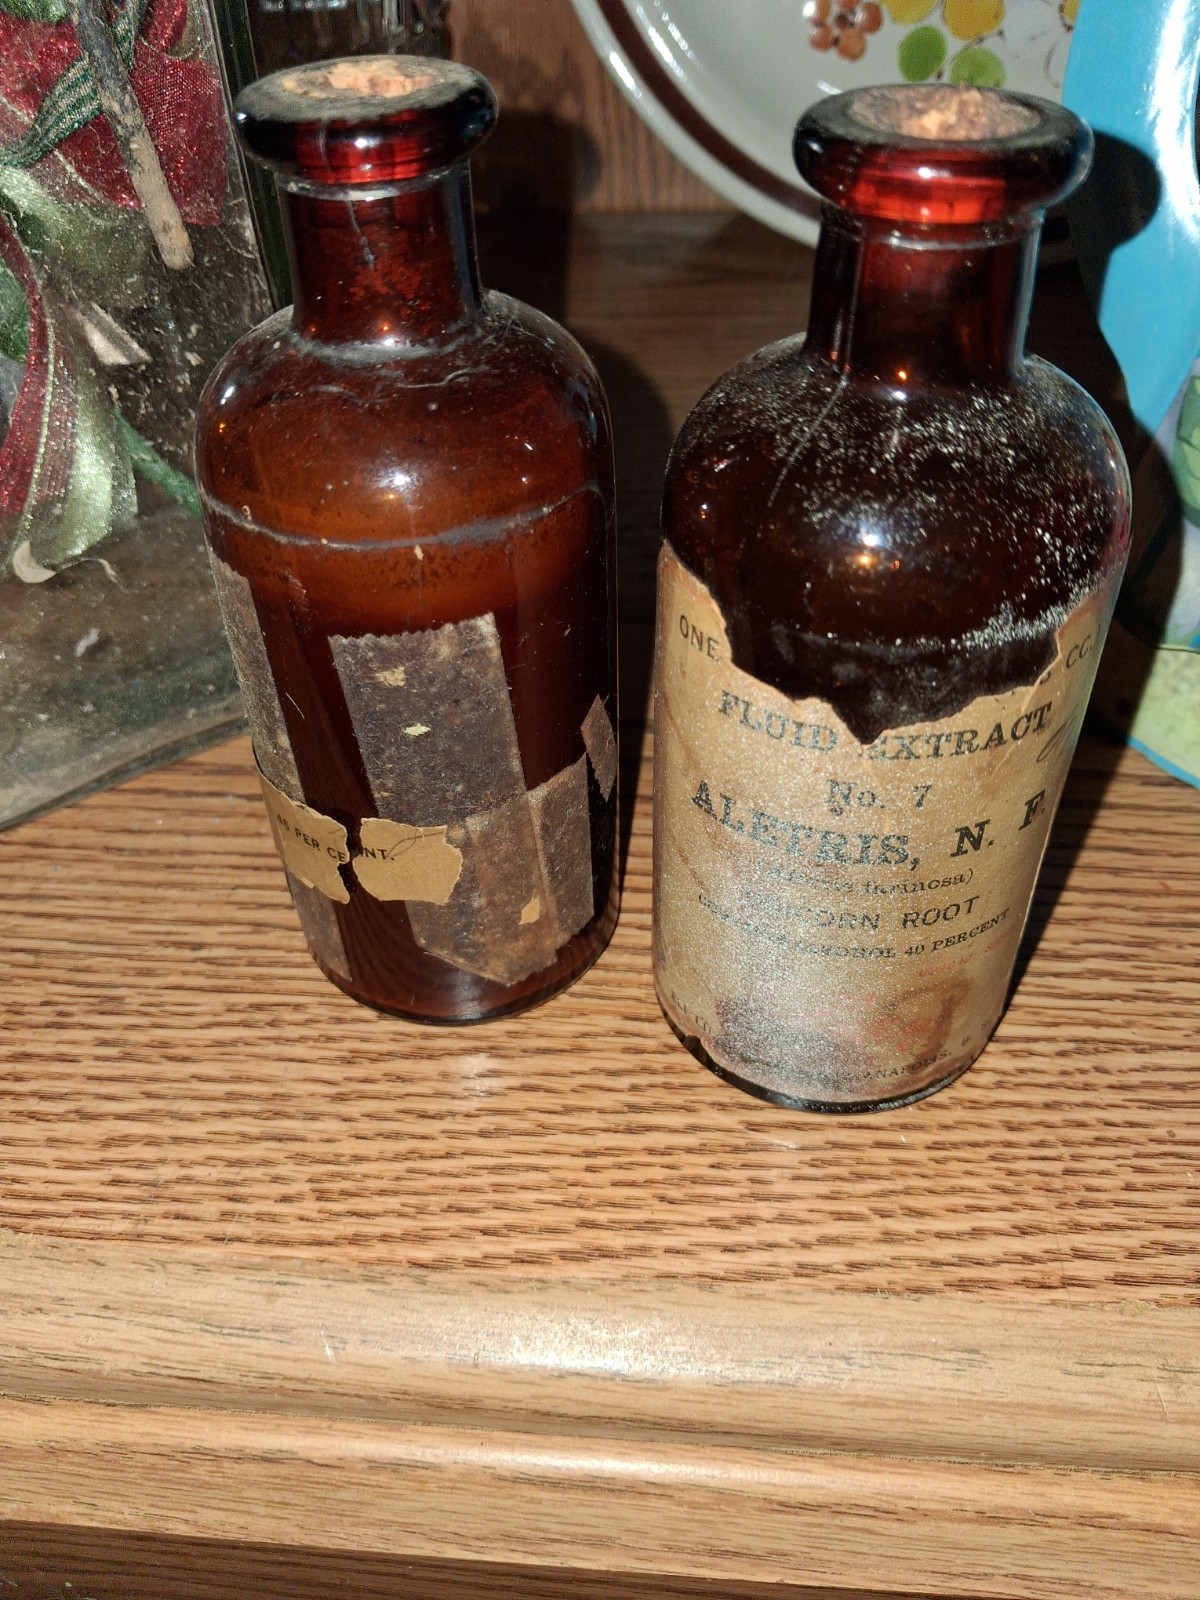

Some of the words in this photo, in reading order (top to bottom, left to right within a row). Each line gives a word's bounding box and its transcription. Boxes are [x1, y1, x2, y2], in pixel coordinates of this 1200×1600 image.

[679, 614, 719, 662] ONE
[719, 690, 837, 752] FLUID
[827, 778, 885, 808] No.
[912, 783, 933, 808] 7
[294, 826, 321, 852] PER
[691, 780, 920, 872] ALETRIS,
[949, 818, 995, 858] N.
[901, 895, 980, 930] ROOT
[904, 943, 925, 957] 40
[931, 907, 1010, 952] PERCENT
